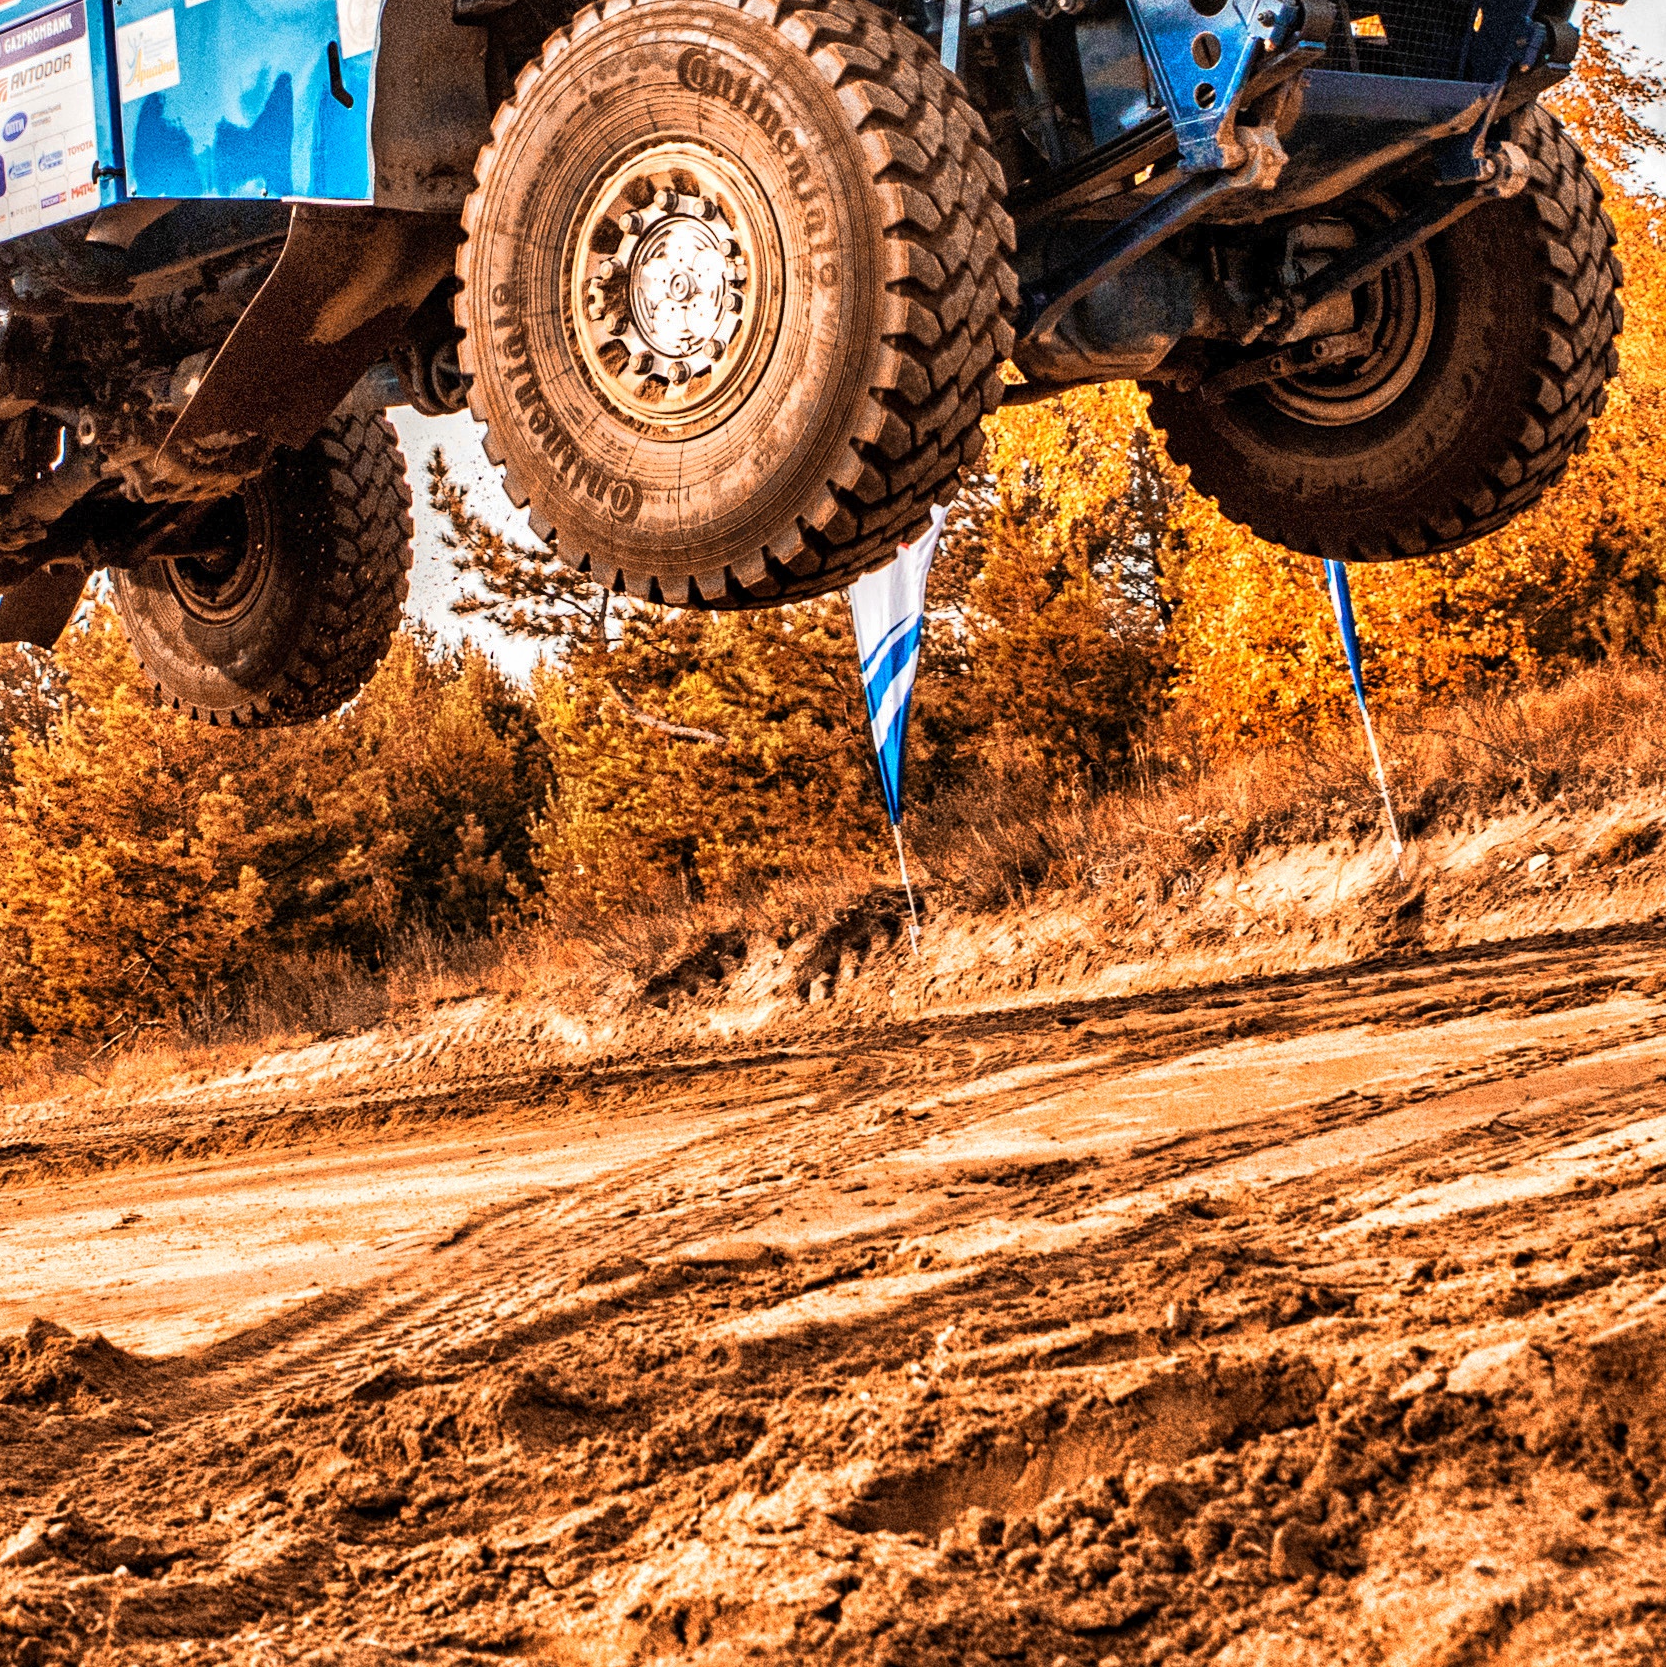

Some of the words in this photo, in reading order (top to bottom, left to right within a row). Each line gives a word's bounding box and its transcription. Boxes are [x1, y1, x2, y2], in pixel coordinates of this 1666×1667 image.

[4, 13, 73, 54] GAZPROMBANK
[10, 53, 72, 91] AVTODOR
[67, 140, 94, 156] TOYOTA
